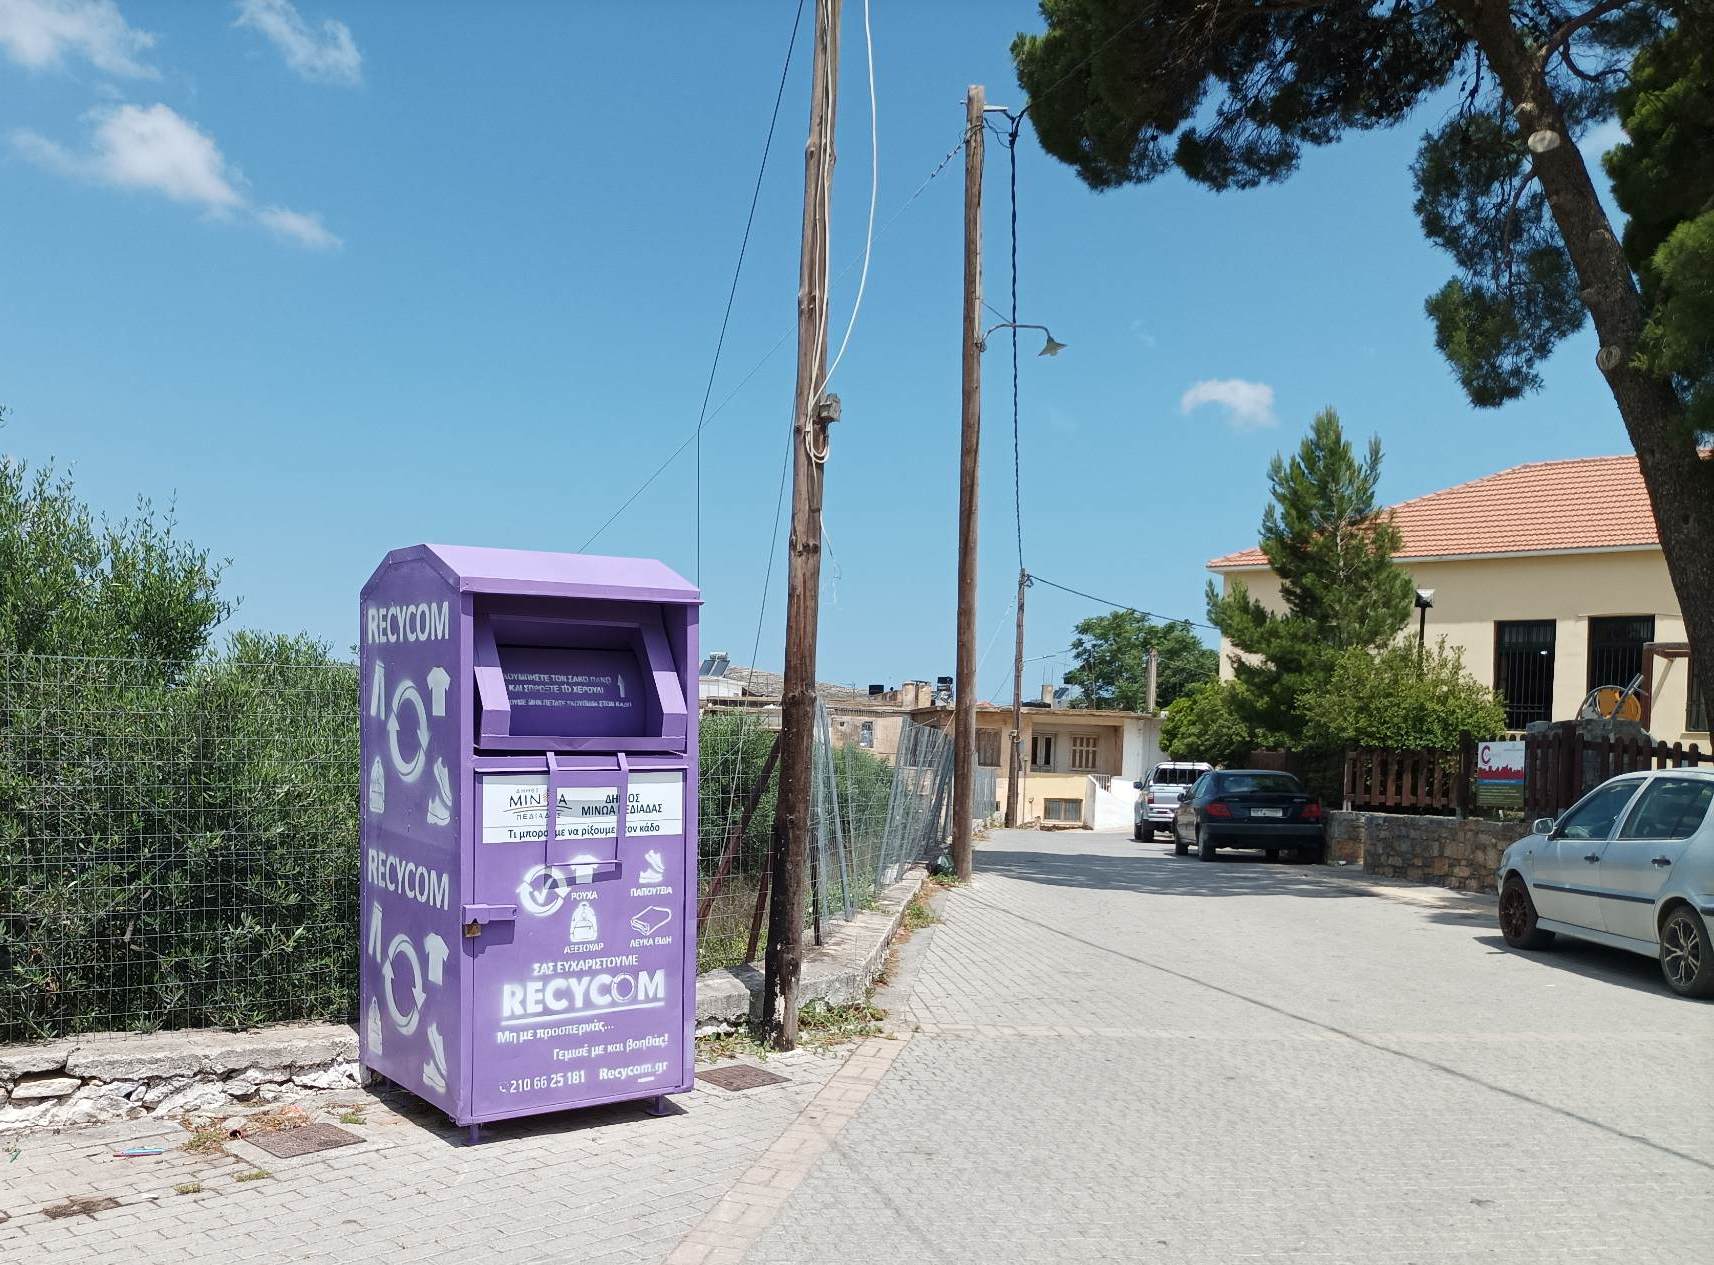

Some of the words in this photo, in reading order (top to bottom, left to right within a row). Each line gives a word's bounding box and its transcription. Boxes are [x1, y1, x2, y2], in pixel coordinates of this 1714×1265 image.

[368, 601, 449, 644] RECYCOM
[509, 684, 523, 692] ΚΑΙ
[561, 684, 572, 693] ΤΟ
[605, 793, 640, 804] ΔΗΟΣ
[516, 812, 561, 821] ΠΕΔΙΑΔΣ
[581, 805, 616, 816] ΜΙΝΩΑ
[508, 829, 517, 839] Τι
[519, 829, 565, 840] μπορομε
[568, 828, 580, 837] να
[582, 825, 616, 837] ρίξουμε
[640, 823, 660, 832] κάδο
[368, 847, 449, 911] RECYCOM
[571, 891, 598, 901] ΡΟΥΧΑ
[564, 942, 604, 954] ΑΞΕΣΟΥΑΡ
[630, 937, 654, 948] ΛΕΥΚΑ
[533, 962, 555, 976] ΣΑΣ
[557, 954, 639, 973] ΕΥΧΑΡΙΣΤΟΥΜΕ
[503, 969, 665, 1017] RECYCOM
[497, 1031, 517, 1044] Μη
[519, 1030, 534, 1042] με
[591, 1044, 605, 1057] με
[607, 1042, 624, 1053] και
[599, 1061, 669, 1081] Recycom.gr
[510, 1078, 531, 1093] 210
[533, 1076, 547, 1089] 66
[550, 1073, 564, 1088] 25
[567, 1070, 585, 1085] 181
